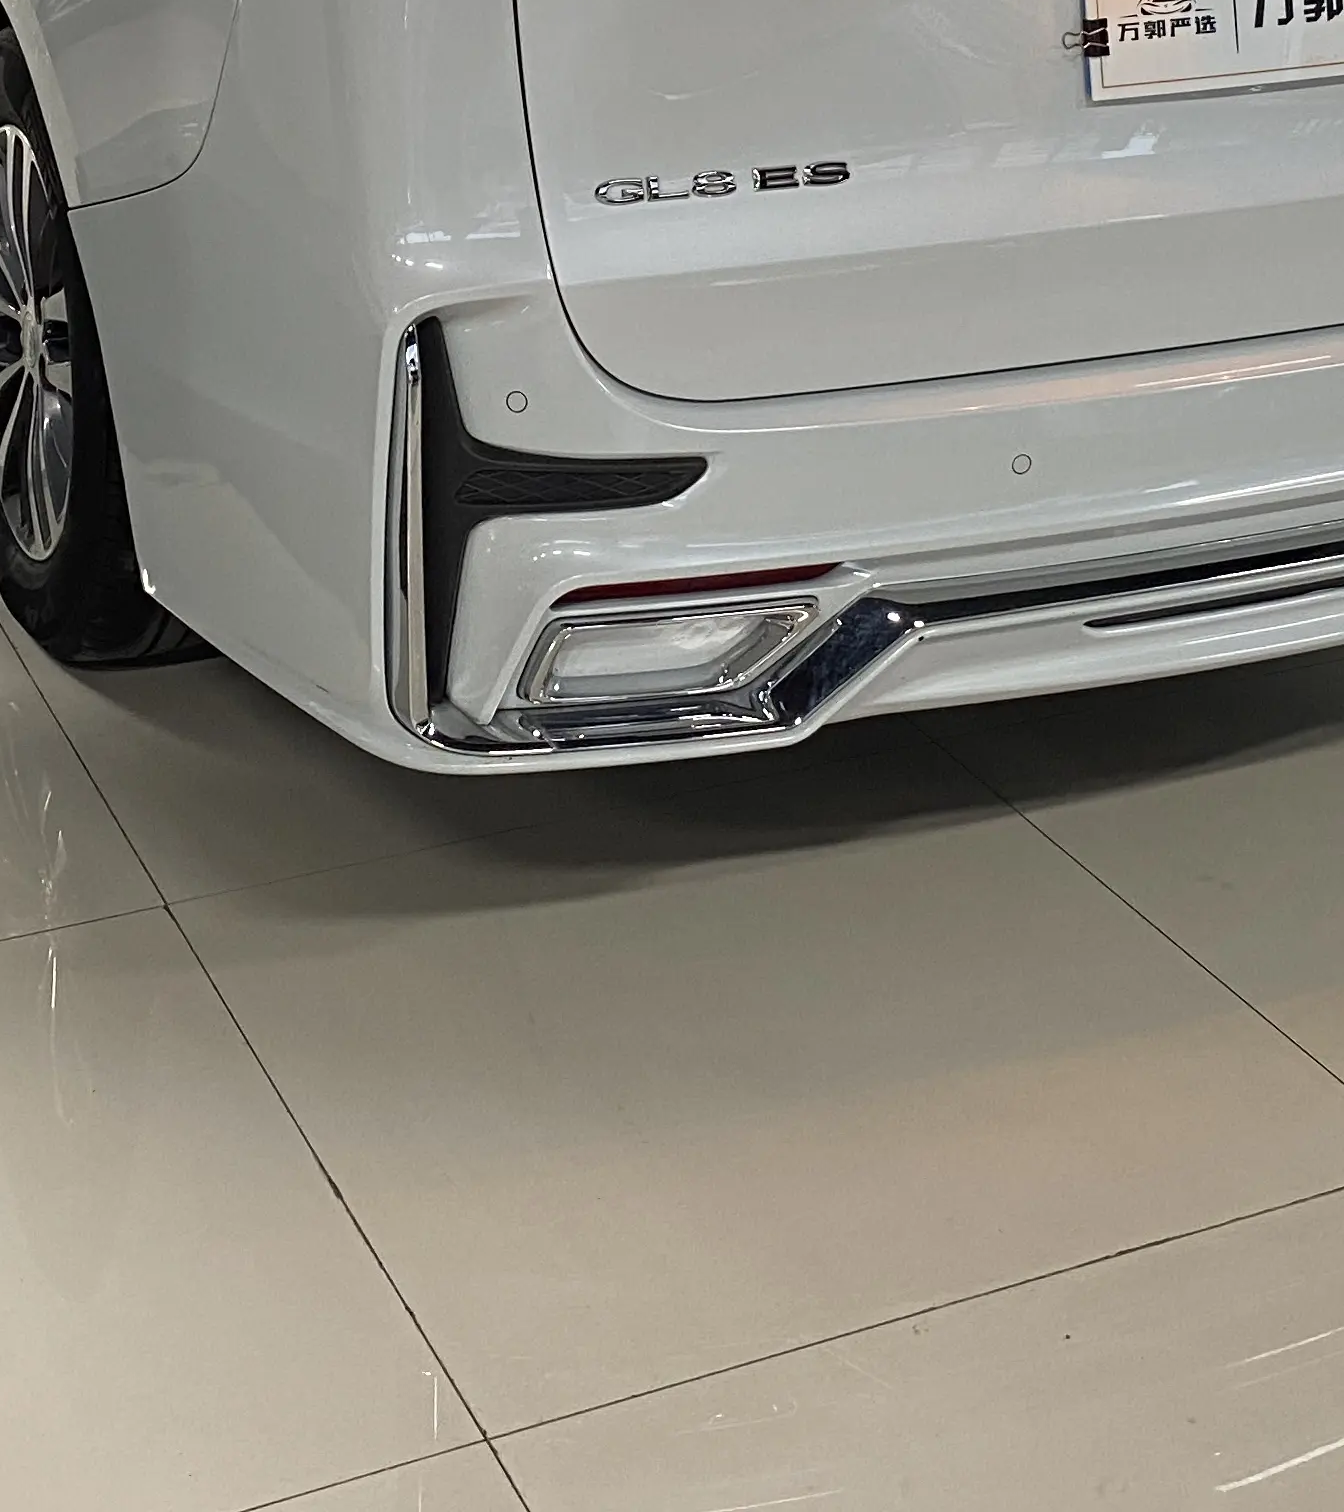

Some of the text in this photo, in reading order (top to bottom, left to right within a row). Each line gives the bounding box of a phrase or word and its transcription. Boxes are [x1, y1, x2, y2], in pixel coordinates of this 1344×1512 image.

[1117, 14, 1218, 42] 万郭严选
[594, 161, 851, 206] GL8 ES
